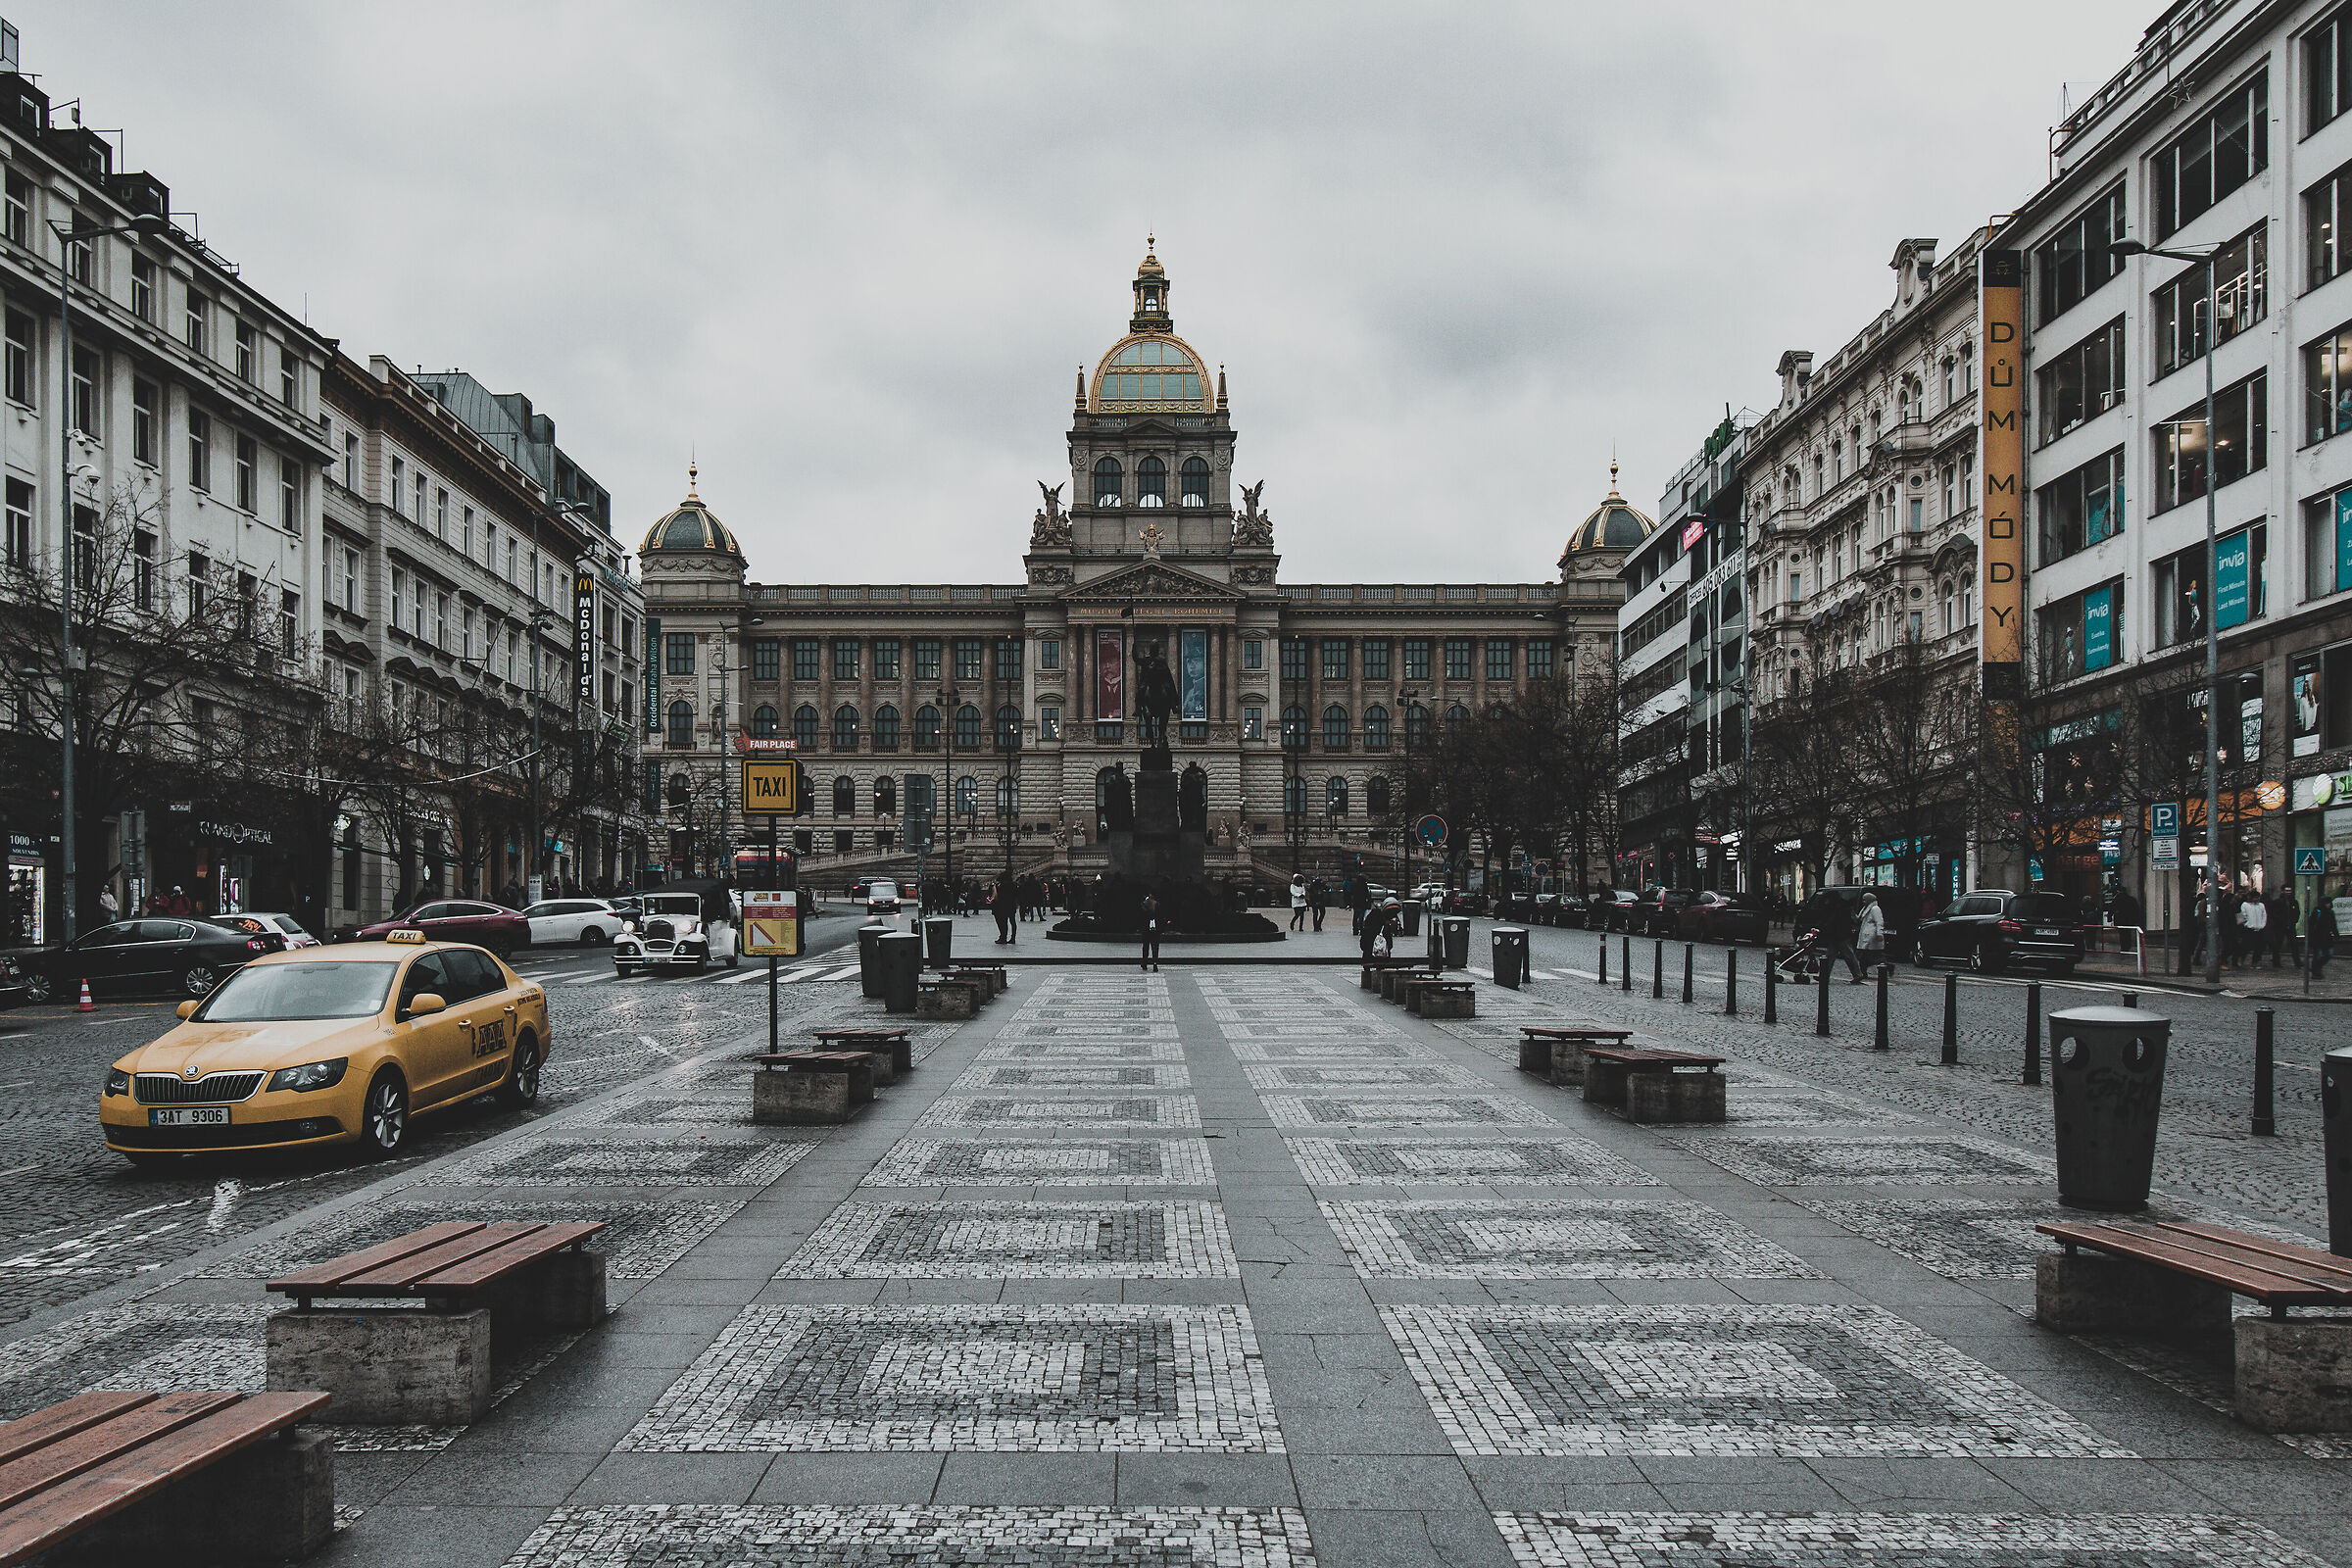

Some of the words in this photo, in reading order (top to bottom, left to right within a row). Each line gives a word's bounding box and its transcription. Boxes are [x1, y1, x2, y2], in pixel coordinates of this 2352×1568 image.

[1988, 321, 2014, 431] DŮM
[1988, 473, 2014, 627] MÓDY
[2219, 550, 2245, 570] invia
[2087, 602, 2109, 619] invia
[2229, 597, 2245, 607] Minute
[579, 597, 592, 696] McDonald's
[750, 740, 768, 749] FAIR
[769, 740, 795, 749] PLACE
[753, 776, 786, 797] TAXI
[2157, 808, 2173, 827] P
[10, 835, 29, 846] 1000
[238, 919, 262, 933] -25%
[160, 1110, 182, 1123] 3AT
[192, 1109, 223, 1123] 9306
